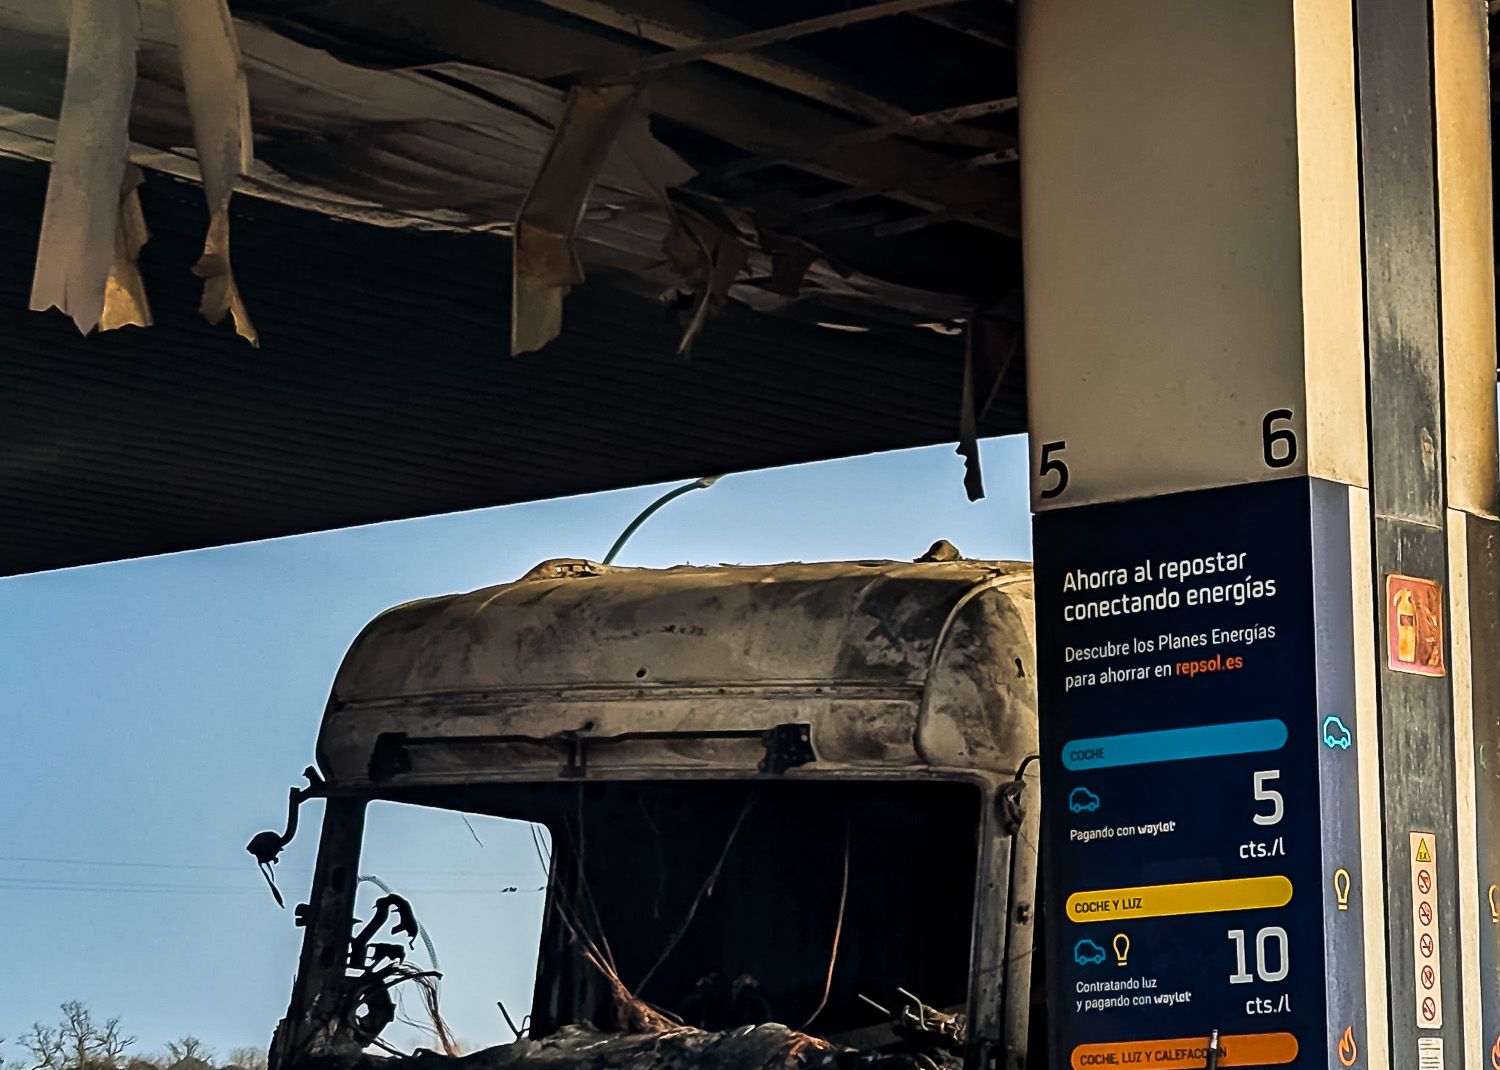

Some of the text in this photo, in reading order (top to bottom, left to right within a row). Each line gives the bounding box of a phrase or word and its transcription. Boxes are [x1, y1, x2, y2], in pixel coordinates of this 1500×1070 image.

[1262, 408, 1299, 469] 6
[1039, 440, 1070, 500] 5
[1063, 551, 1247, 593] Ahorra al repostar
[1064, 575, 1277, 622] conectando energías
[1065, 622, 1276, 663] Descubre los Planes Energías
[1065, 654, 1244, 692] para ahorrar en repsol.es
[1070, 747, 1105, 762] COCHE
[1252, 769, 1284, 826] 5
[1070, 825, 1114, 843] Pagando
[1116, 826, 1136, 837] con
[1074, 897, 1143, 914] COCHE Y LUZ
[1227, 926, 1290, 984] 10
[1076, 976, 1157, 993] Contratando luz
[1076, 1000, 1083, 1012] y
[1085, 995, 1130, 1011] pagando
[1132, 995, 1152, 1006] con
[1080, 1047, 1227, 1066] COCHE, LUZ Y CALEFACCN
